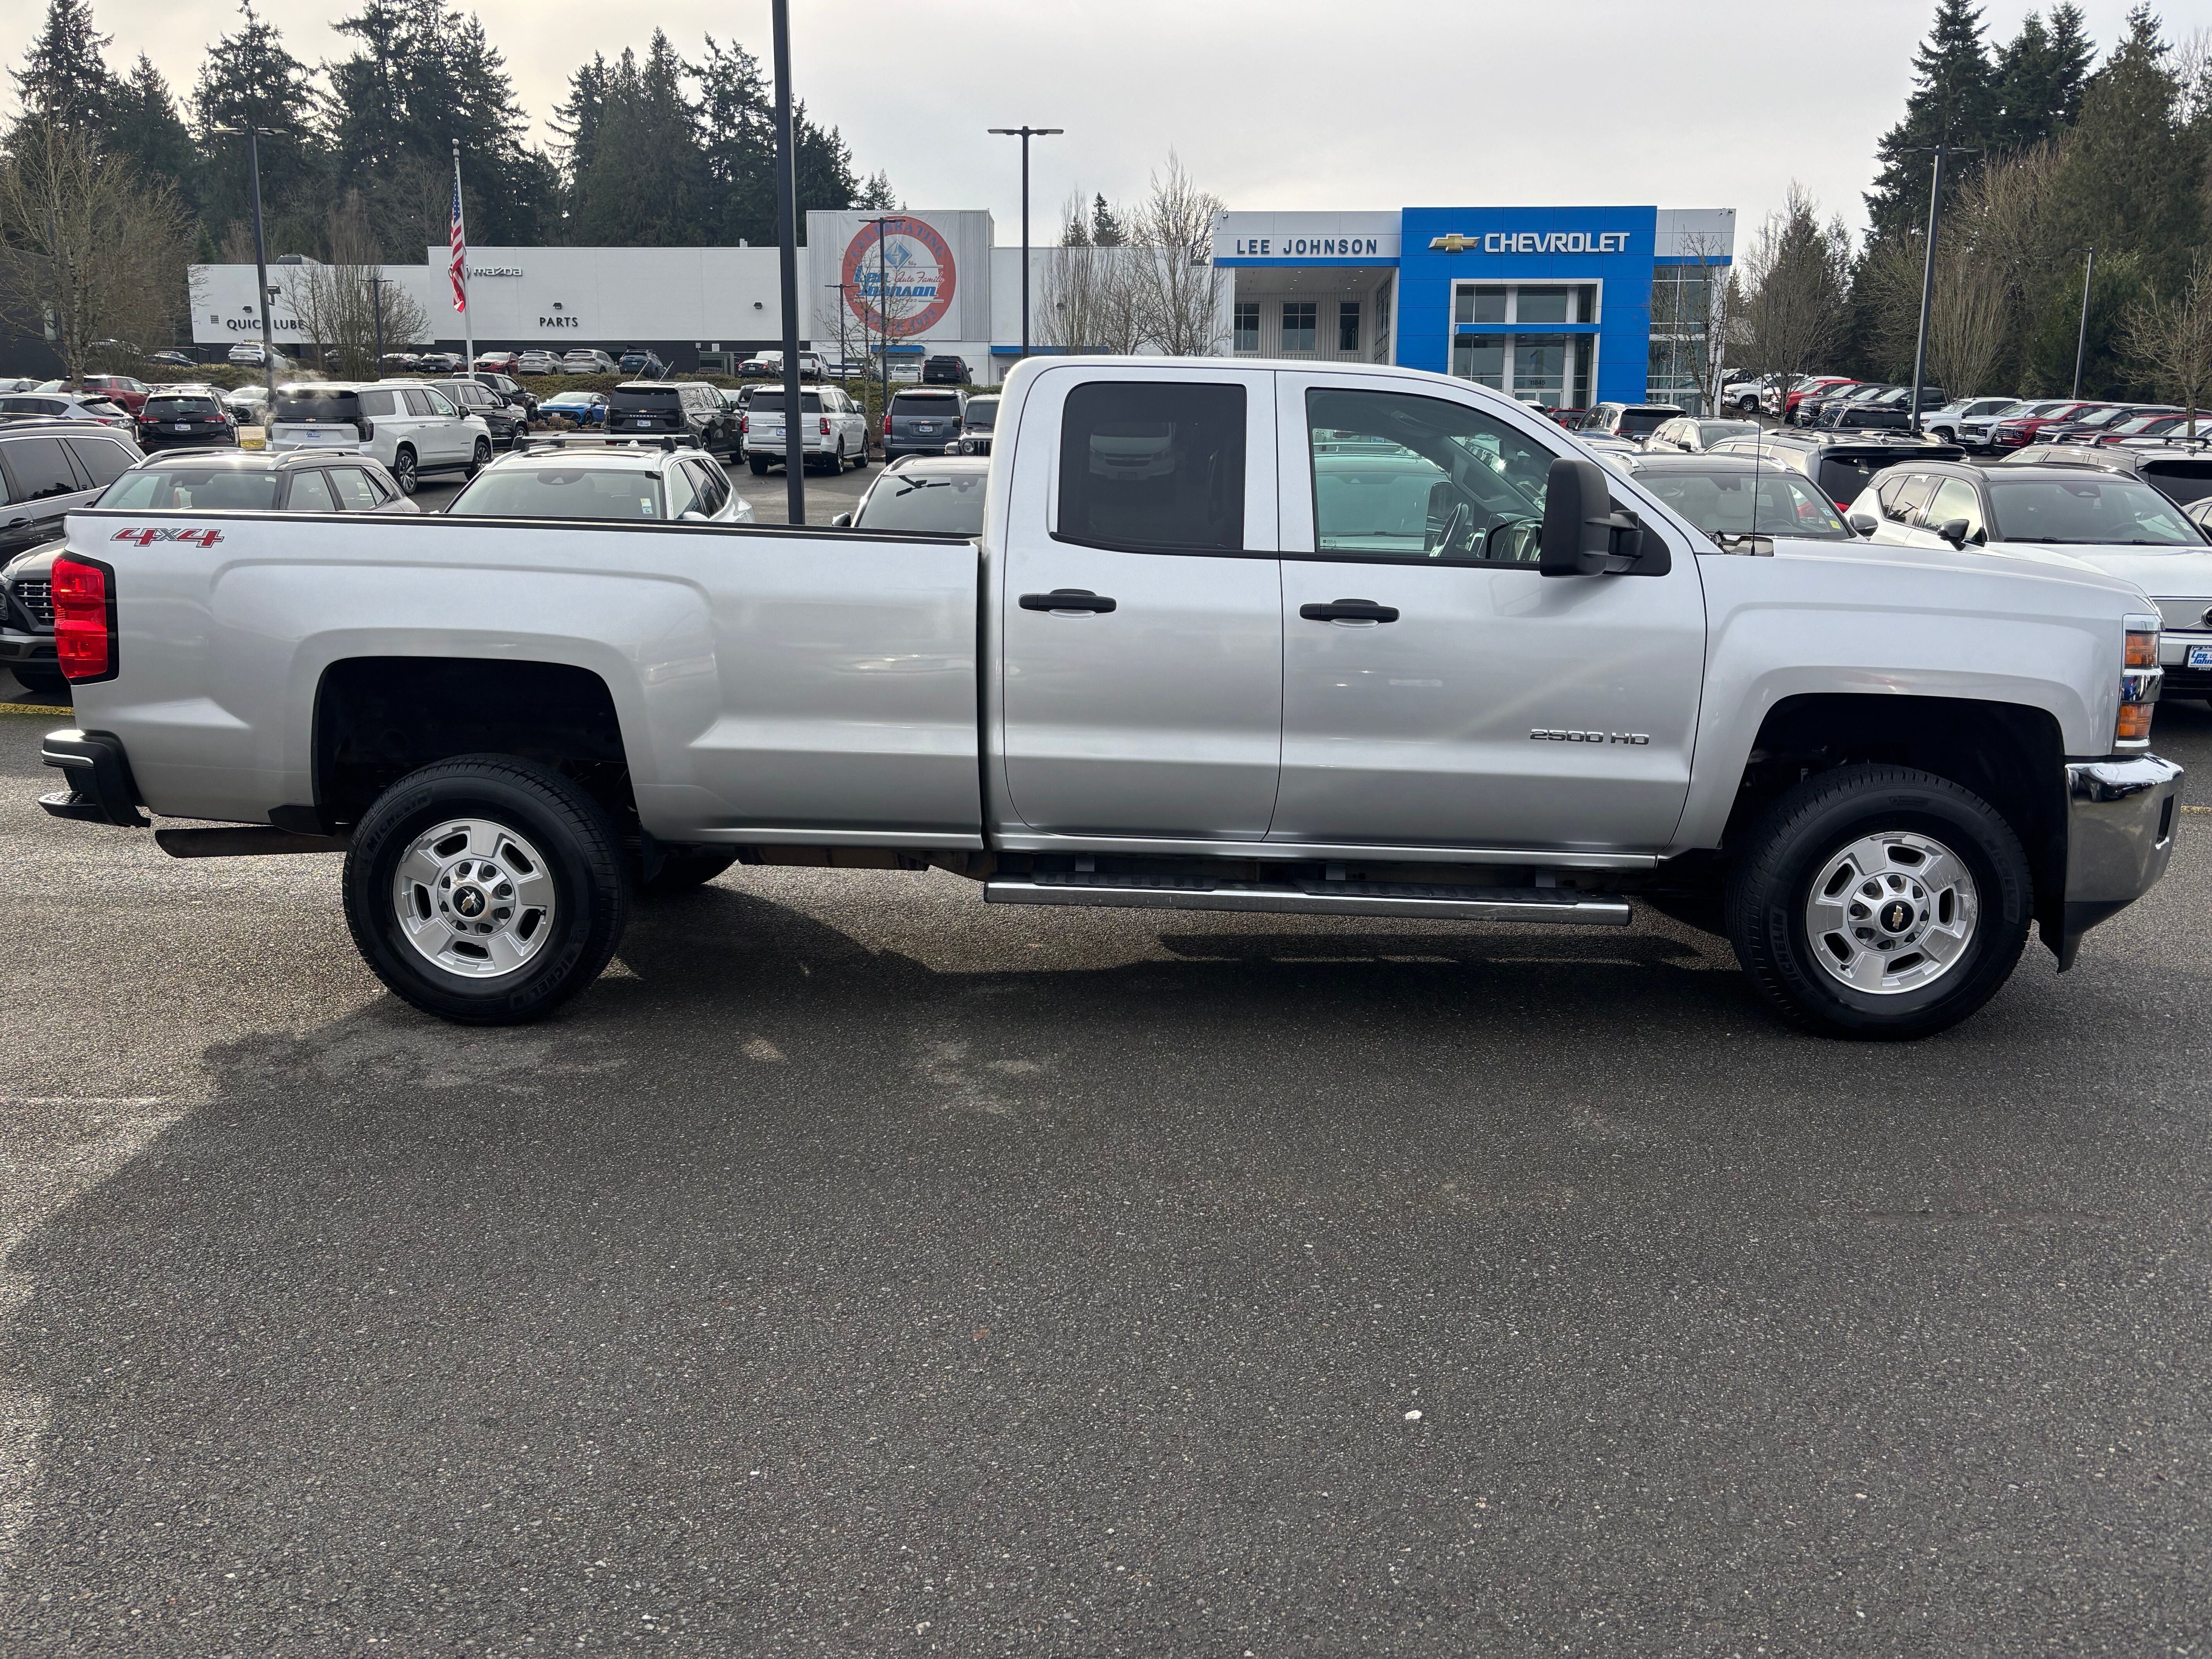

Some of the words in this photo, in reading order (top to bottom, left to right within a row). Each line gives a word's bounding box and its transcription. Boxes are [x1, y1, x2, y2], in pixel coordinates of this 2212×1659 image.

[1237, 239, 1270, 255] LEE
[1283, 239, 1377, 255] JOHNSON
[1484, 232, 1630, 252] CHEVROLET
[895, 271, 915, 283] Auto
[916, 271, 945, 287] Family
[226, 319, 262, 331] QUIC
[273, 319, 305, 330] LUBE
[539, 317, 578, 327] PARTS
[1530, 729, 1604, 743] 2500
[1610, 732, 1650, 745] HD
